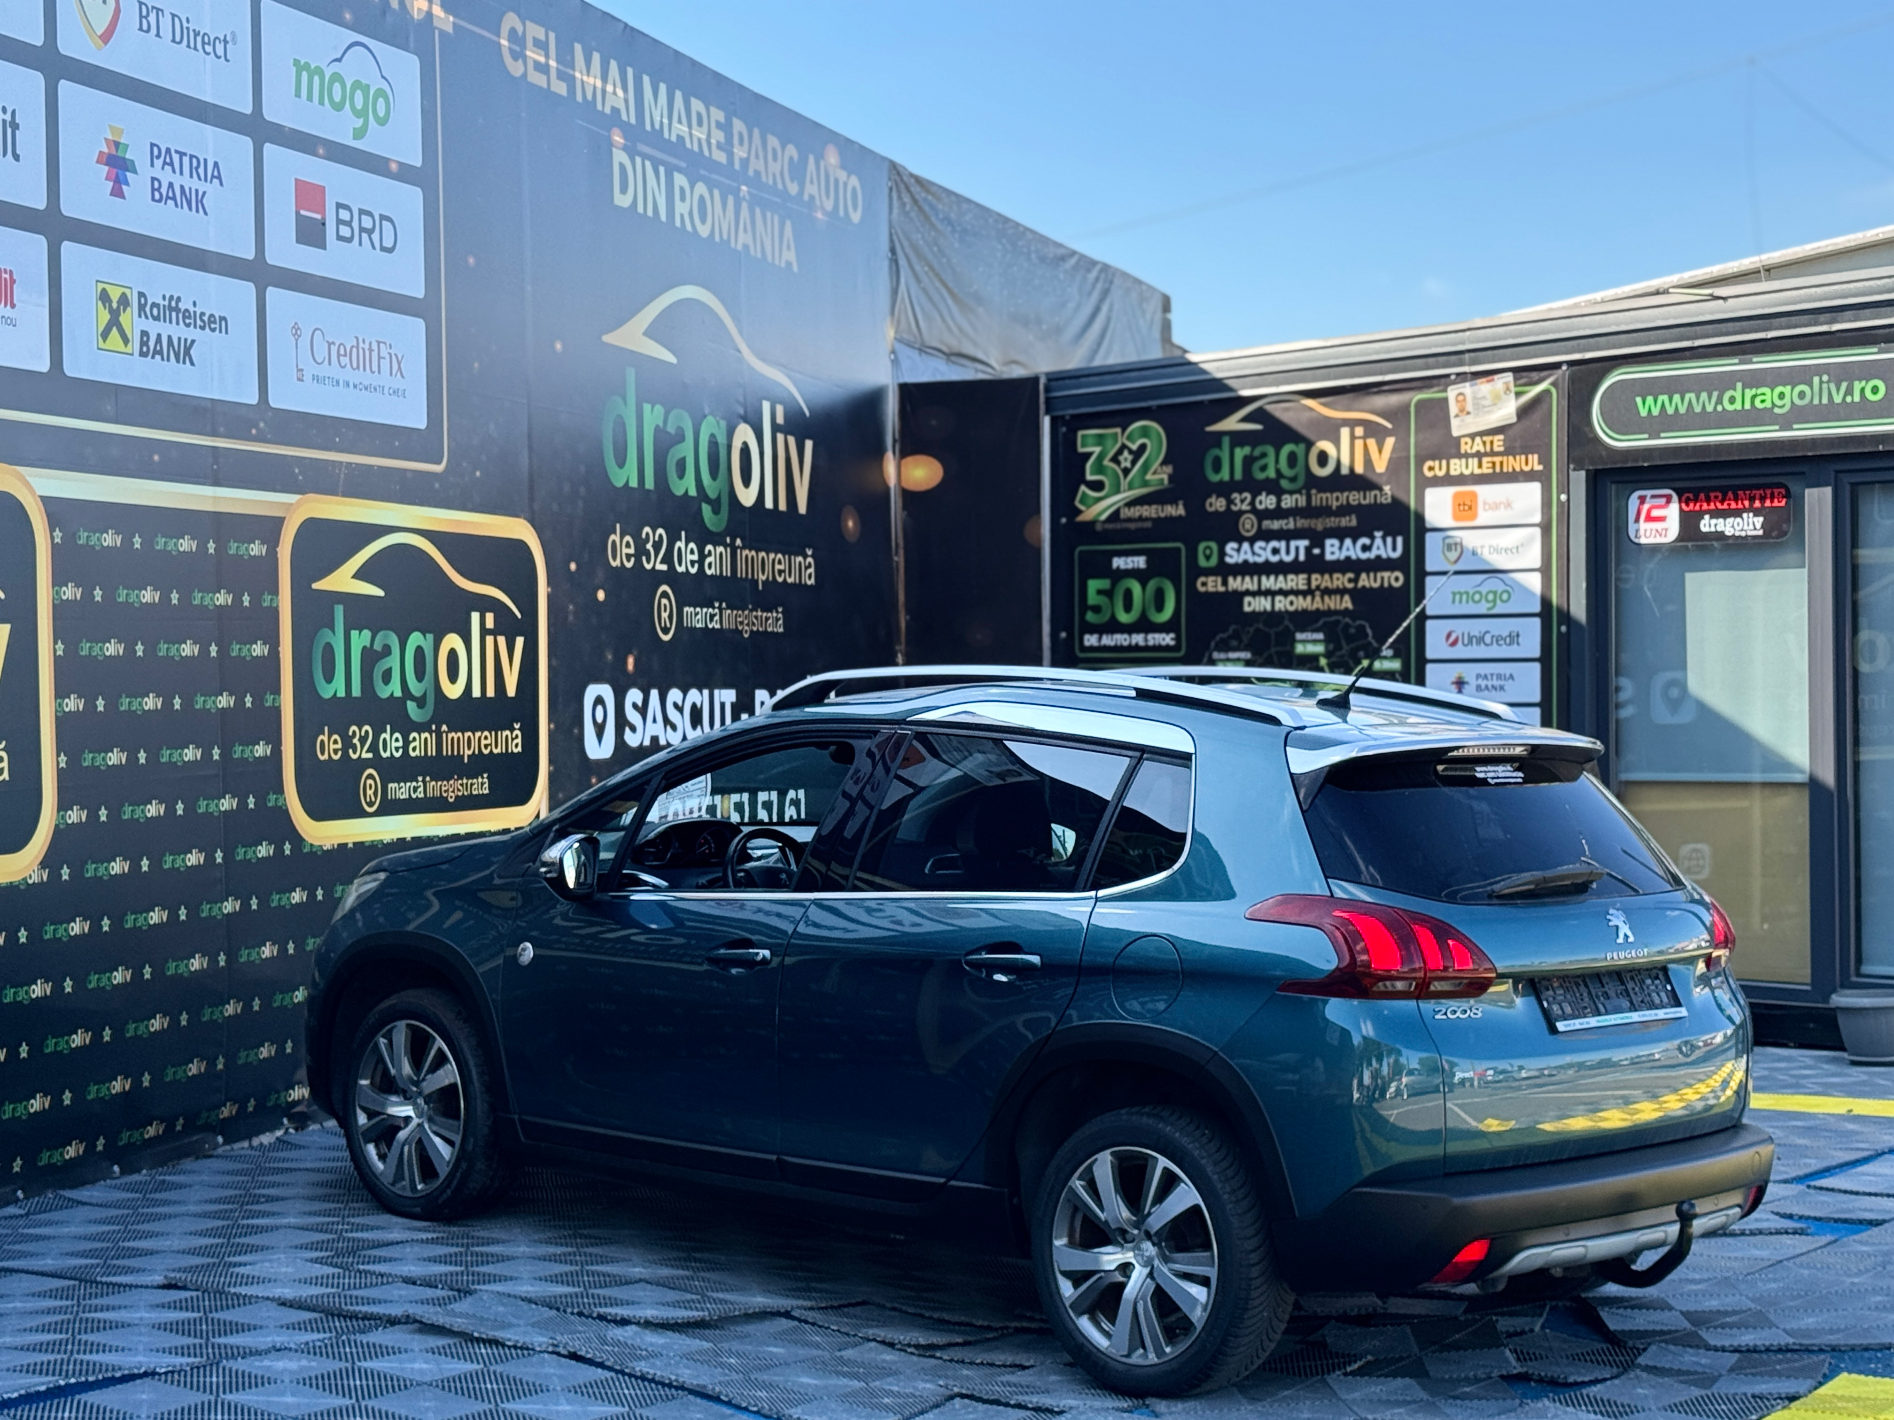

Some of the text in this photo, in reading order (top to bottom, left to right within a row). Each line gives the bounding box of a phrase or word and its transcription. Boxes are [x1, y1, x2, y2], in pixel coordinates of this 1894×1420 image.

[137, 0, 165, 39] BT
[292, 57, 392, 141] mogo
[500, 11, 567, 97] CEL
[574, 42, 636, 125] MAI
[642, 74, 727, 164] MARE
[732, 117, 799, 197] PARC
[803, 153, 863, 224] AUTO
[149, 141, 225, 188] PATRIA
[150, 176, 209, 216] BANK
[611, 147, 799, 273] DIN ROMÂNIA
[335, 201, 398, 255] BRD
[137, 291, 229, 335] Raiffeisen
[138, 329, 197, 367] BANK
[309, 327, 405, 379] CreditFix
[311, 373, 341, 388] PRIETEN
[342, 379, 350, 389] IN
[352, 381, 386, 396] MOMENTE
[1635, 375, 1887, 417] www.dragoliv.ro
[602, 366, 814, 533] dragoliv
[1204, 426, 1396, 491] dragoliv
[1460, 435, 1505, 454] RATE
[1074, 420, 1168, 513] 32
[1423, 453, 1543, 477] CU BULETINUL
[1205, 485, 1392, 512] de 32 de ani împreună
[1457, 499, 1513, 512] tbi bank
[1633, 493, 1673, 524] 12
[1680, 488, 1788, 512] GARANTIE
[1262, 516, 1295, 530] marcă
[1634, 528, 1669, 539] LUNI
[1700, 512, 1764, 536] dragoliv
[76, 528, 267, 558] dragoliv dragoliv dragoliv
[607, 523, 816, 590] de 32 de ani împreună
[1224, 539, 1310, 564] SASCUT
[1324, 531, 1403, 561] BACĂU
[1445, 541, 1460, 552] BT
[1472, 546, 1486, 557] BT
[1112, 556, 1147, 570] PESTE
[53, 582, 233, 608] goliv dragoliv dragoliv
[1196, 571, 1404, 592] CEL MAI MARE PARC AUTO
[1084, 576, 1176, 625] 500
[1243, 592, 1353, 612] DIN ROMÂNIA
[1450, 588, 1512, 611] mogo
[683, 602, 721, 630] marcă
[722, 603, 785, 639] înregistrată
[78, 638, 269, 661] dragoliv dragoliv dragoliv
[1083, 633, 1176, 647] DE AUTO PE STOC
[1461, 630, 1521, 647] UniCredit
[312, 604, 525, 723] dragoliv
[1475, 672, 1515, 682] PATRIA
[1475, 684, 1507, 693] BANK
[56, 692, 235, 716] goliv dragoliv dragoliv
[623, 687, 737, 748] SASCUT
[81, 740, 272, 769] dragoliv dragoliv dragoliv
[316, 723, 523, 763] de 32 de ani împreună
[387, 774, 425, 800] marcă
[426, 772, 490, 803] înregistrată
[121, 799, 165, 822] dragoliv
[196, 794, 238, 816] dragoliv
[84, 856, 130, 880] dragoliv
[162, 849, 205, 871] dragoliv
[235, 841, 275, 862] dragoliv
[43, 917, 90, 941] dragoliv
[123, 906, 168, 930] dragoliv
[200, 896, 241, 919] dragoliv
[269, 887, 308, 908] dragoliv
[1606, 948, 1649, 961] PEUGEOT
[1, 978, 52, 1004] dragoliv
[86, 966, 132, 990] dragoliv
[165, 953, 208, 977] dragoliv
[238, 941, 278, 964] dragoliv
[201, 999, 243, 1023] dragoliv
[1433, 1006, 1483, 1020] 2008
